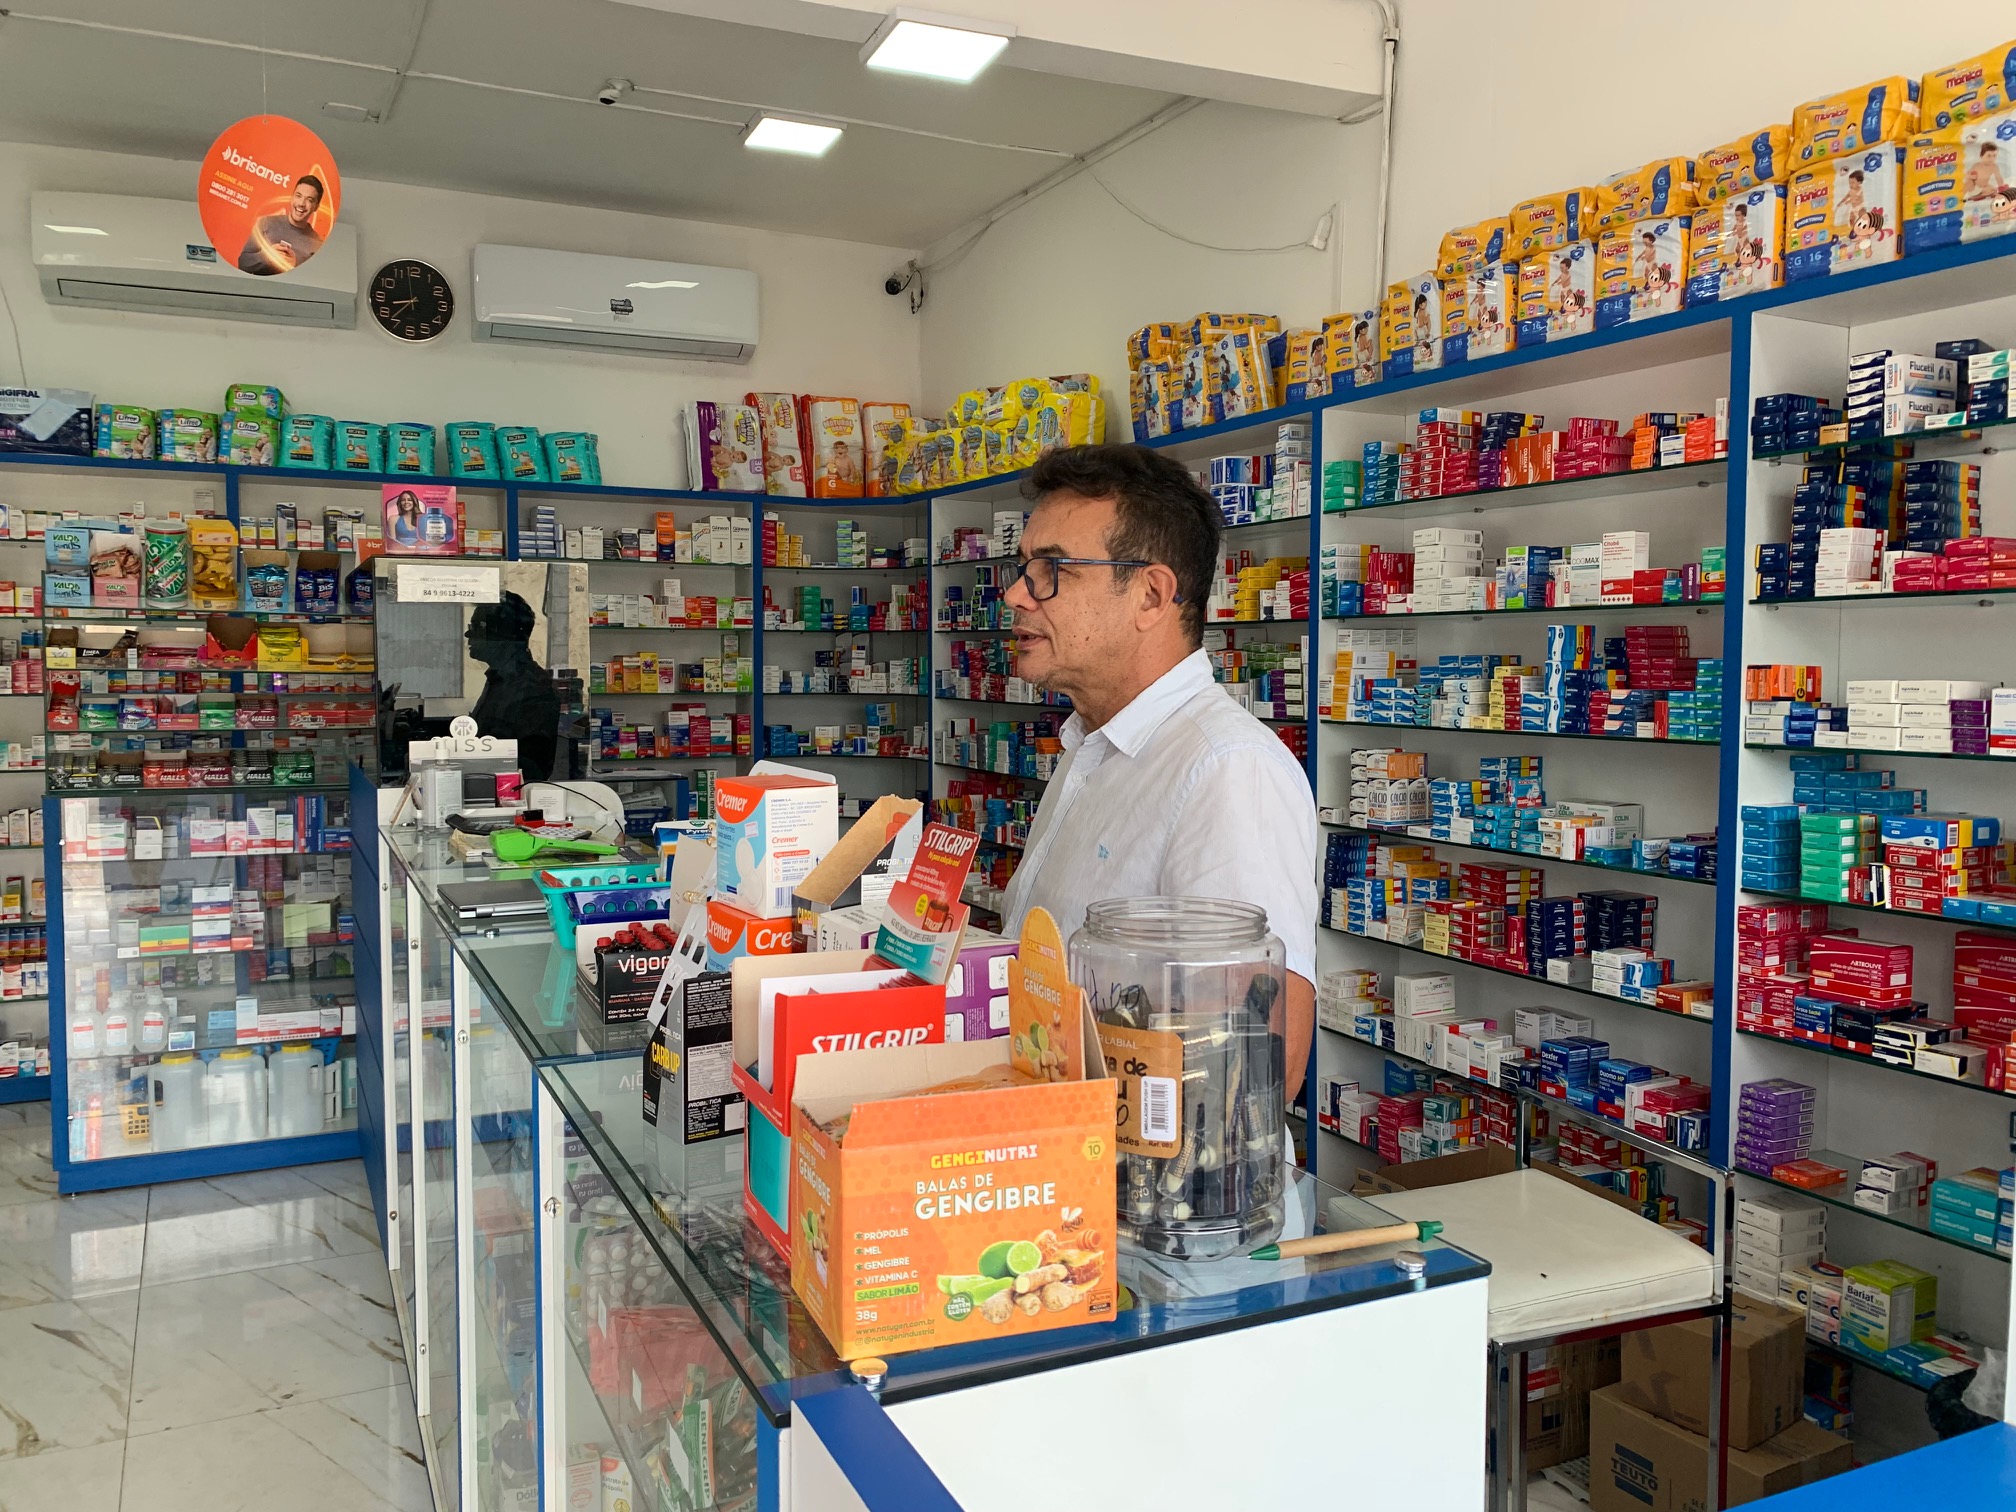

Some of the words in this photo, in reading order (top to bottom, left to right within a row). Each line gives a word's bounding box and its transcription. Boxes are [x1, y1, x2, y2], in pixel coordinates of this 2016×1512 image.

[230, 149, 290, 188] brisanet
[215, 170, 237, 185] ASSINE
[237, 180, 253, 192] AQUI
[211, 181, 227, 193] 0800
[236, 192, 250, 203] 3017
[1919, 180, 1955, 195] SHORTINHO
[1919, 221, 1928, 230] M
[1936, 217, 1948, 227] 18
[1795, 257, 1801, 266] G
[1809, 252, 1821, 262] 16
[394, 268, 404, 279] 11
[407, 266, 420, 277] 12
[381, 278, 395, 289] 10
[427, 273, 432, 284] 1
[376, 291, 385, 302] 9
[433, 286, 443, 297] 2
[438, 301, 447, 312] 3
[1603, 302, 1609, 311] G
[1614, 299, 1624, 309] 16
[380, 307, 390, 318] 8
[390, 318, 400, 329] 7
[432, 315, 442, 326] 4
[406, 325, 415, 337] 6
[420, 323, 430, 334] 5
[1455, 339, 1463, 347] 16
[1909, 360, 1935, 373] Flucetil
[1908, 401, 1934, 413] Flucetil
[118, 414, 138, 423] Lifree
[181, 418, 199, 427] Lifree
[828, 478, 837, 489] G
[53, 534, 80, 543] VALDA
[1572, 557, 1599, 565] COGMAX
[54, 581, 81, 590] VALDA
[439, 590, 475, 598] 9613-4222
[251, 715, 276, 723] HALLS
[204, 772, 230, 781] HALLS
[247, 772, 272, 781] HALLS
[289, 772, 313, 780] HALLS
[716, 788, 749, 813] Cremer
[1369, 791, 1387, 804] CÁLCIO
[1390, 792, 1407, 804] CÁLCIO
[1410, 791, 1426, 802] CÁLCIO
[771, 836, 799, 845] Cremer
[707, 916, 732, 944] Cremer
[1851, 960, 1882, 969] ARTROLIVE
[1024, 978, 1061, 1007] GENGIBRE
[1105, 1037, 1139, 1050] LABIAL
[652, 1041, 670, 1070] CARB
[670, 1052, 681, 1074] UP
[1542, 1051, 1558, 1062] Dexfer
[1124, 1057, 1148, 1077] de
[1600, 1070, 1616, 1080] Duomo
[1144, 1080, 1149, 1088] UP
[1087, 1145, 1101, 1156] 10
[931, 1144, 1038, 1169] GENGINUTRI
[799, 1158, 831, 1207] GENGIBRE
[915, 1176, 967, 1195] BALAS
[974, 1173, 993, 1187] DE
[915, 1183, 1056, 1220] GENGIBRE
[863, 1228, 909, 1240] PRÓPOLIS
[863, 1246, 882, 1255] MEL
[864, 1257, 910, 1270] GENGIBRE
[864, 1272, 909, 1284] VITAMINA
[911, 1270, 919, 1278] C
[857, 1290, 888, 1301] SABOR
[888, 1285, 919, 1297] LIMÃO
[1847, 1285, 1874, 1303] Bariat
[856, 1310, 878, 1321] 38g
[856, 1318, 936, 1335] www.natugen.com.br
[863, 1328, 935, 1345] @natugenindustria
[701, 1410, 711, 1500] BENEGRIP
[1611, 1457, 1659, 1492] TEUTO
[602, 1475, 621, 1486] Extrato
[602, 1483, 624, 1493] Própolis
